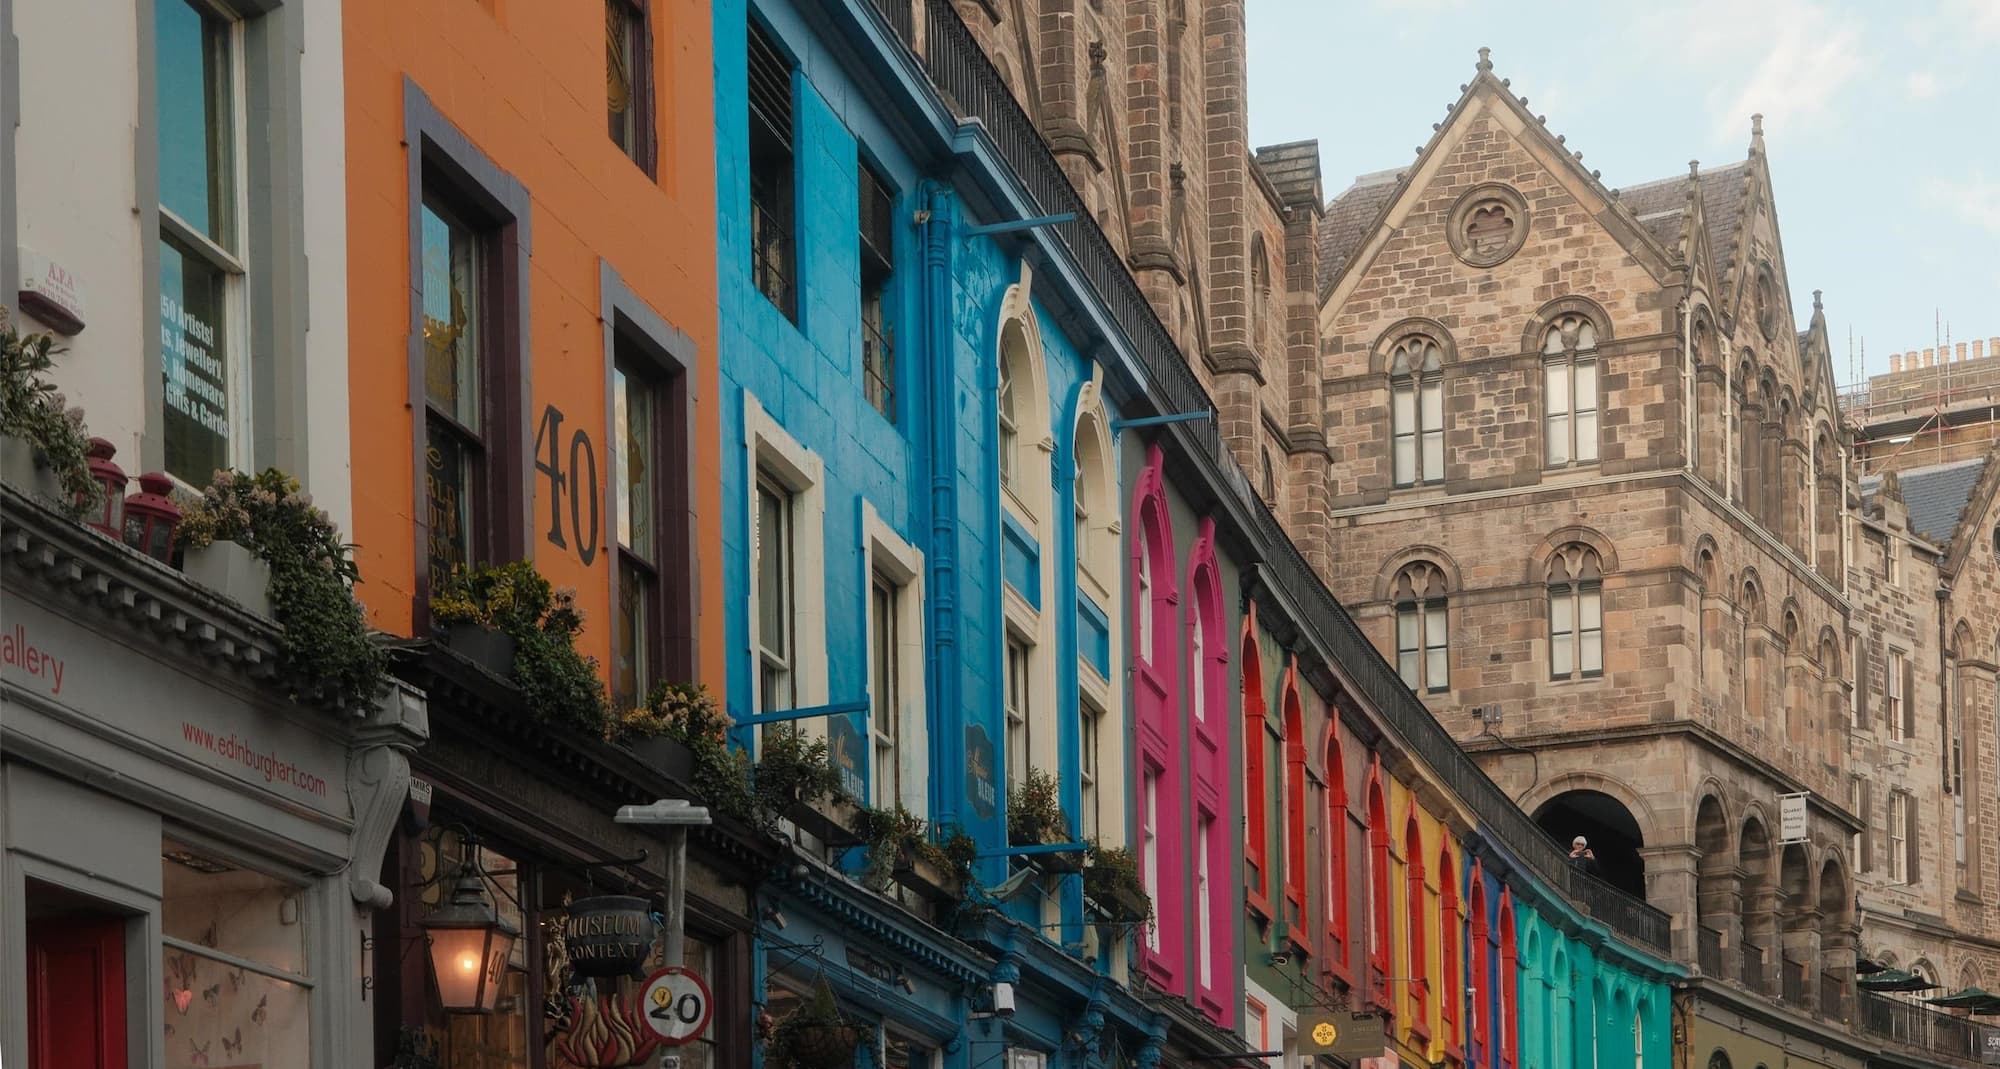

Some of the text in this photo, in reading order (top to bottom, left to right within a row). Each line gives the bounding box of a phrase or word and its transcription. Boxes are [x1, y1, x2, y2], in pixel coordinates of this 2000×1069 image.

[178, 305, 214, 347] Artists!
[175, 331, 223, 384] Jewellery,
[166, 382, 229, 439] Gifts & Cards
[535, 404, 598, 567] 40
[0, 624, 64, 695] allery
[182, 721, 326, 798] www.edinburghart.com
[567, 914, 640, 939] MUSEUM
[488, 950, 505, 985] 40
[569, 942, 639, 960] CONTEXT
[650, 988, 701, 1024] 20
